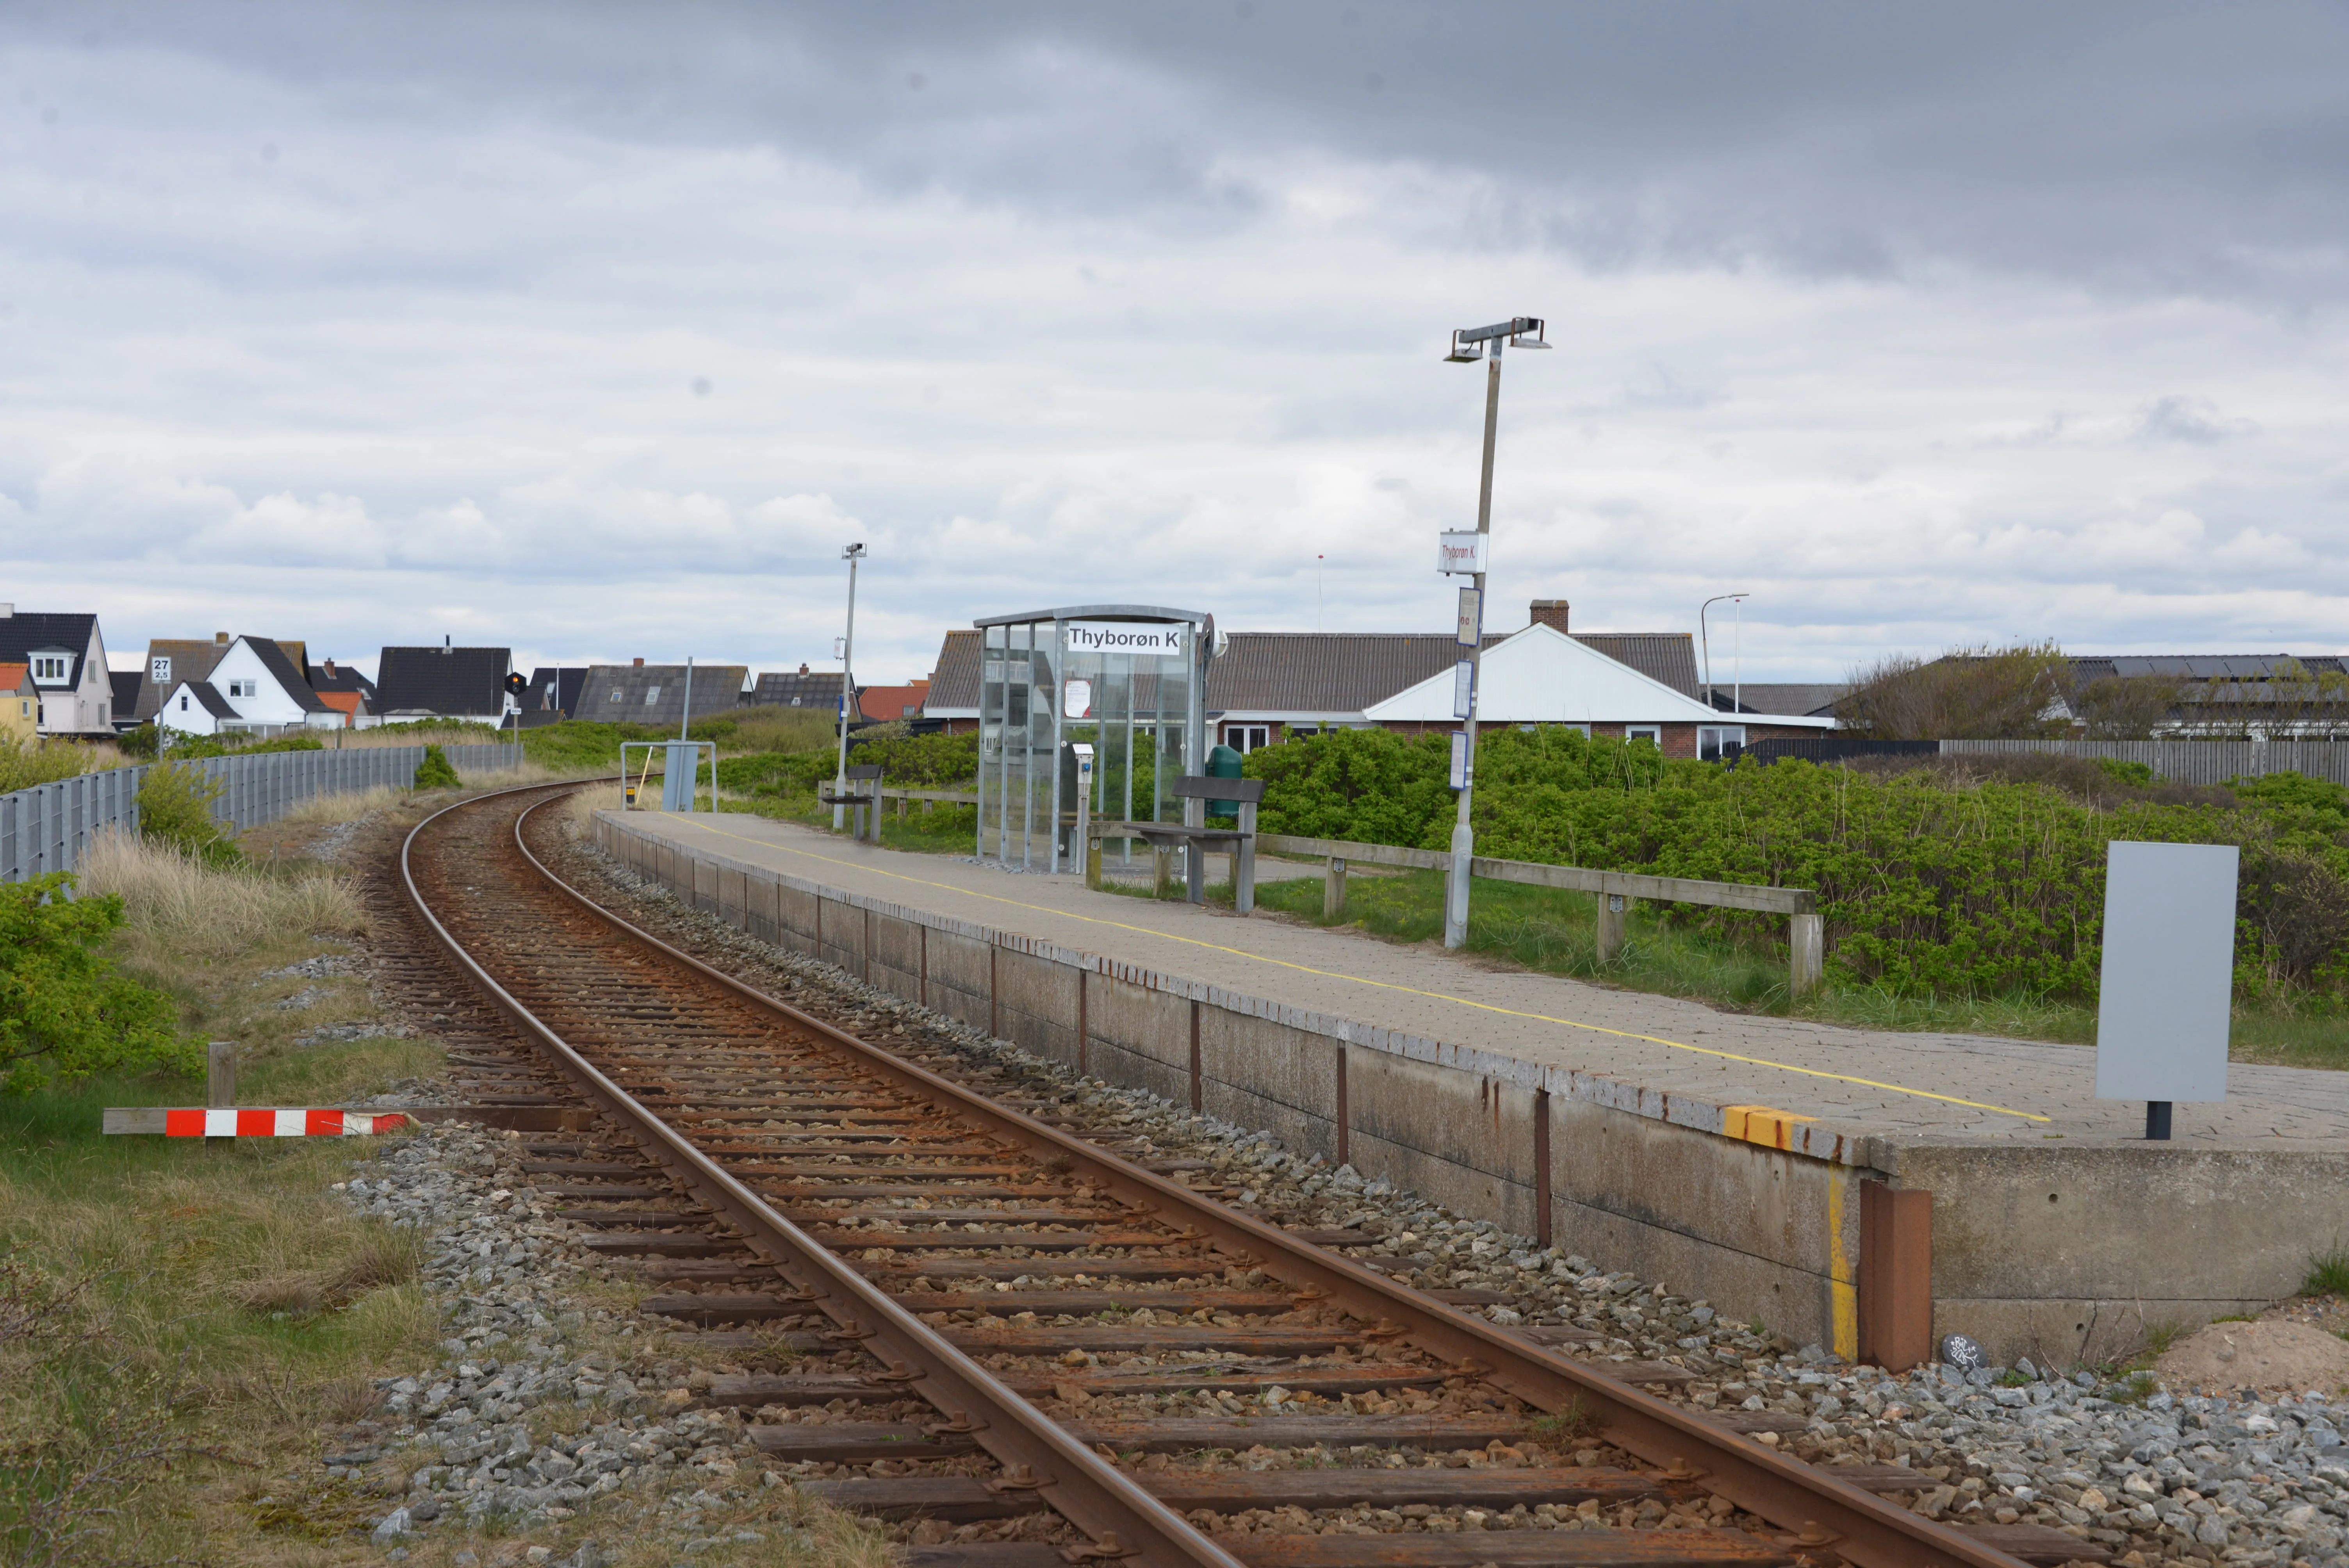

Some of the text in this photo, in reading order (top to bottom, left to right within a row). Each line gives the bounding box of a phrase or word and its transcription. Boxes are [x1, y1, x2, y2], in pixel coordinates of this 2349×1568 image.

[1443, 544, 1468, 561] Thyborøn
[1069, 628, 1178, 649] Thyborøn K
[154, 660, 168, 669] 27
